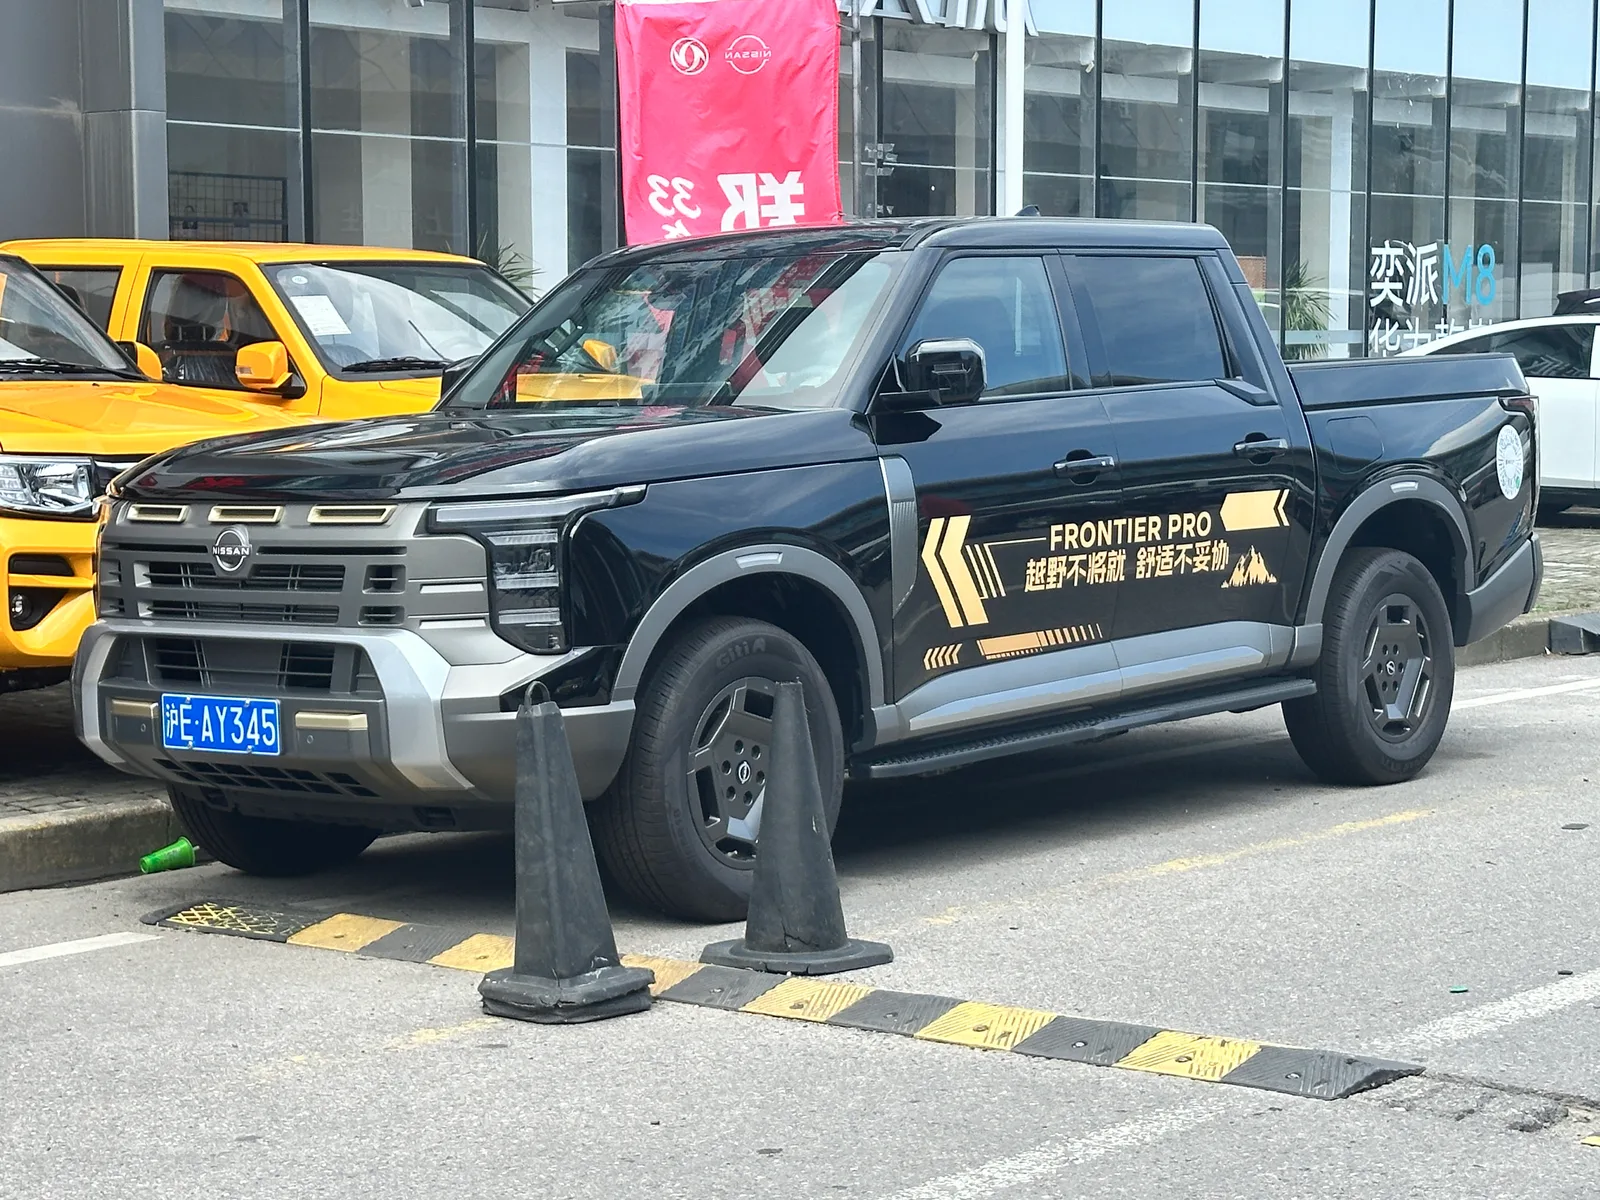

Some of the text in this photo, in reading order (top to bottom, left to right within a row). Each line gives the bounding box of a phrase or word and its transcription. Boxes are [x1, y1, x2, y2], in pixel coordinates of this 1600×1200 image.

[1369, 239, 1497, 308] 奕派M8
[1368, 316, 1494, 357] 华为
[212, 546, 250, 555] NISSAN
[1049, 510, 1213, 552] FRONTIER PRO
[1023, 539, 1231, 593] 越野不将就 舒适不妥协
